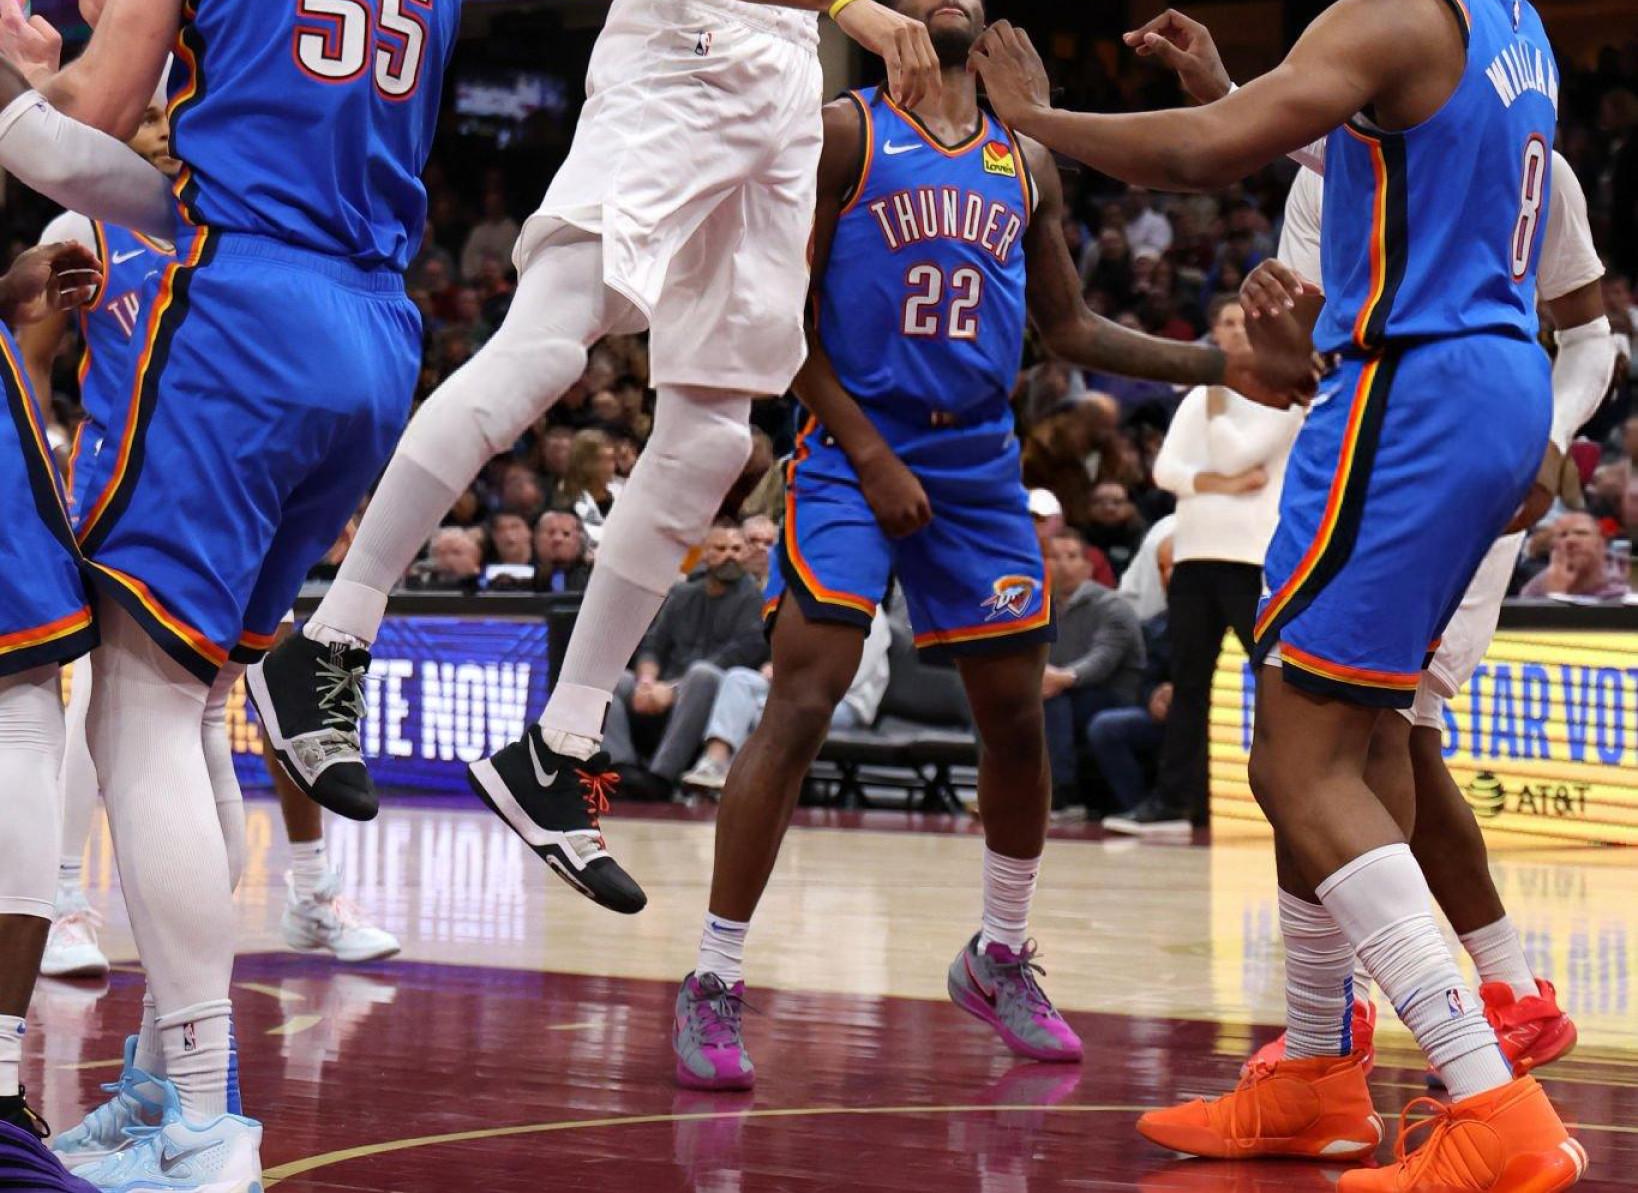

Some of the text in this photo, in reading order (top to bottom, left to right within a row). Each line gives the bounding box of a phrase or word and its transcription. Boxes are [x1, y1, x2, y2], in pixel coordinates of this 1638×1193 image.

[870, 188, 1022, 262] THUNDER
[1512, 134, 1547, 282] 8
[903, 263, 983, 340] 22
[421, 660, 531, 762] NOW
[1517, 784, 1590, 816] AT&T
